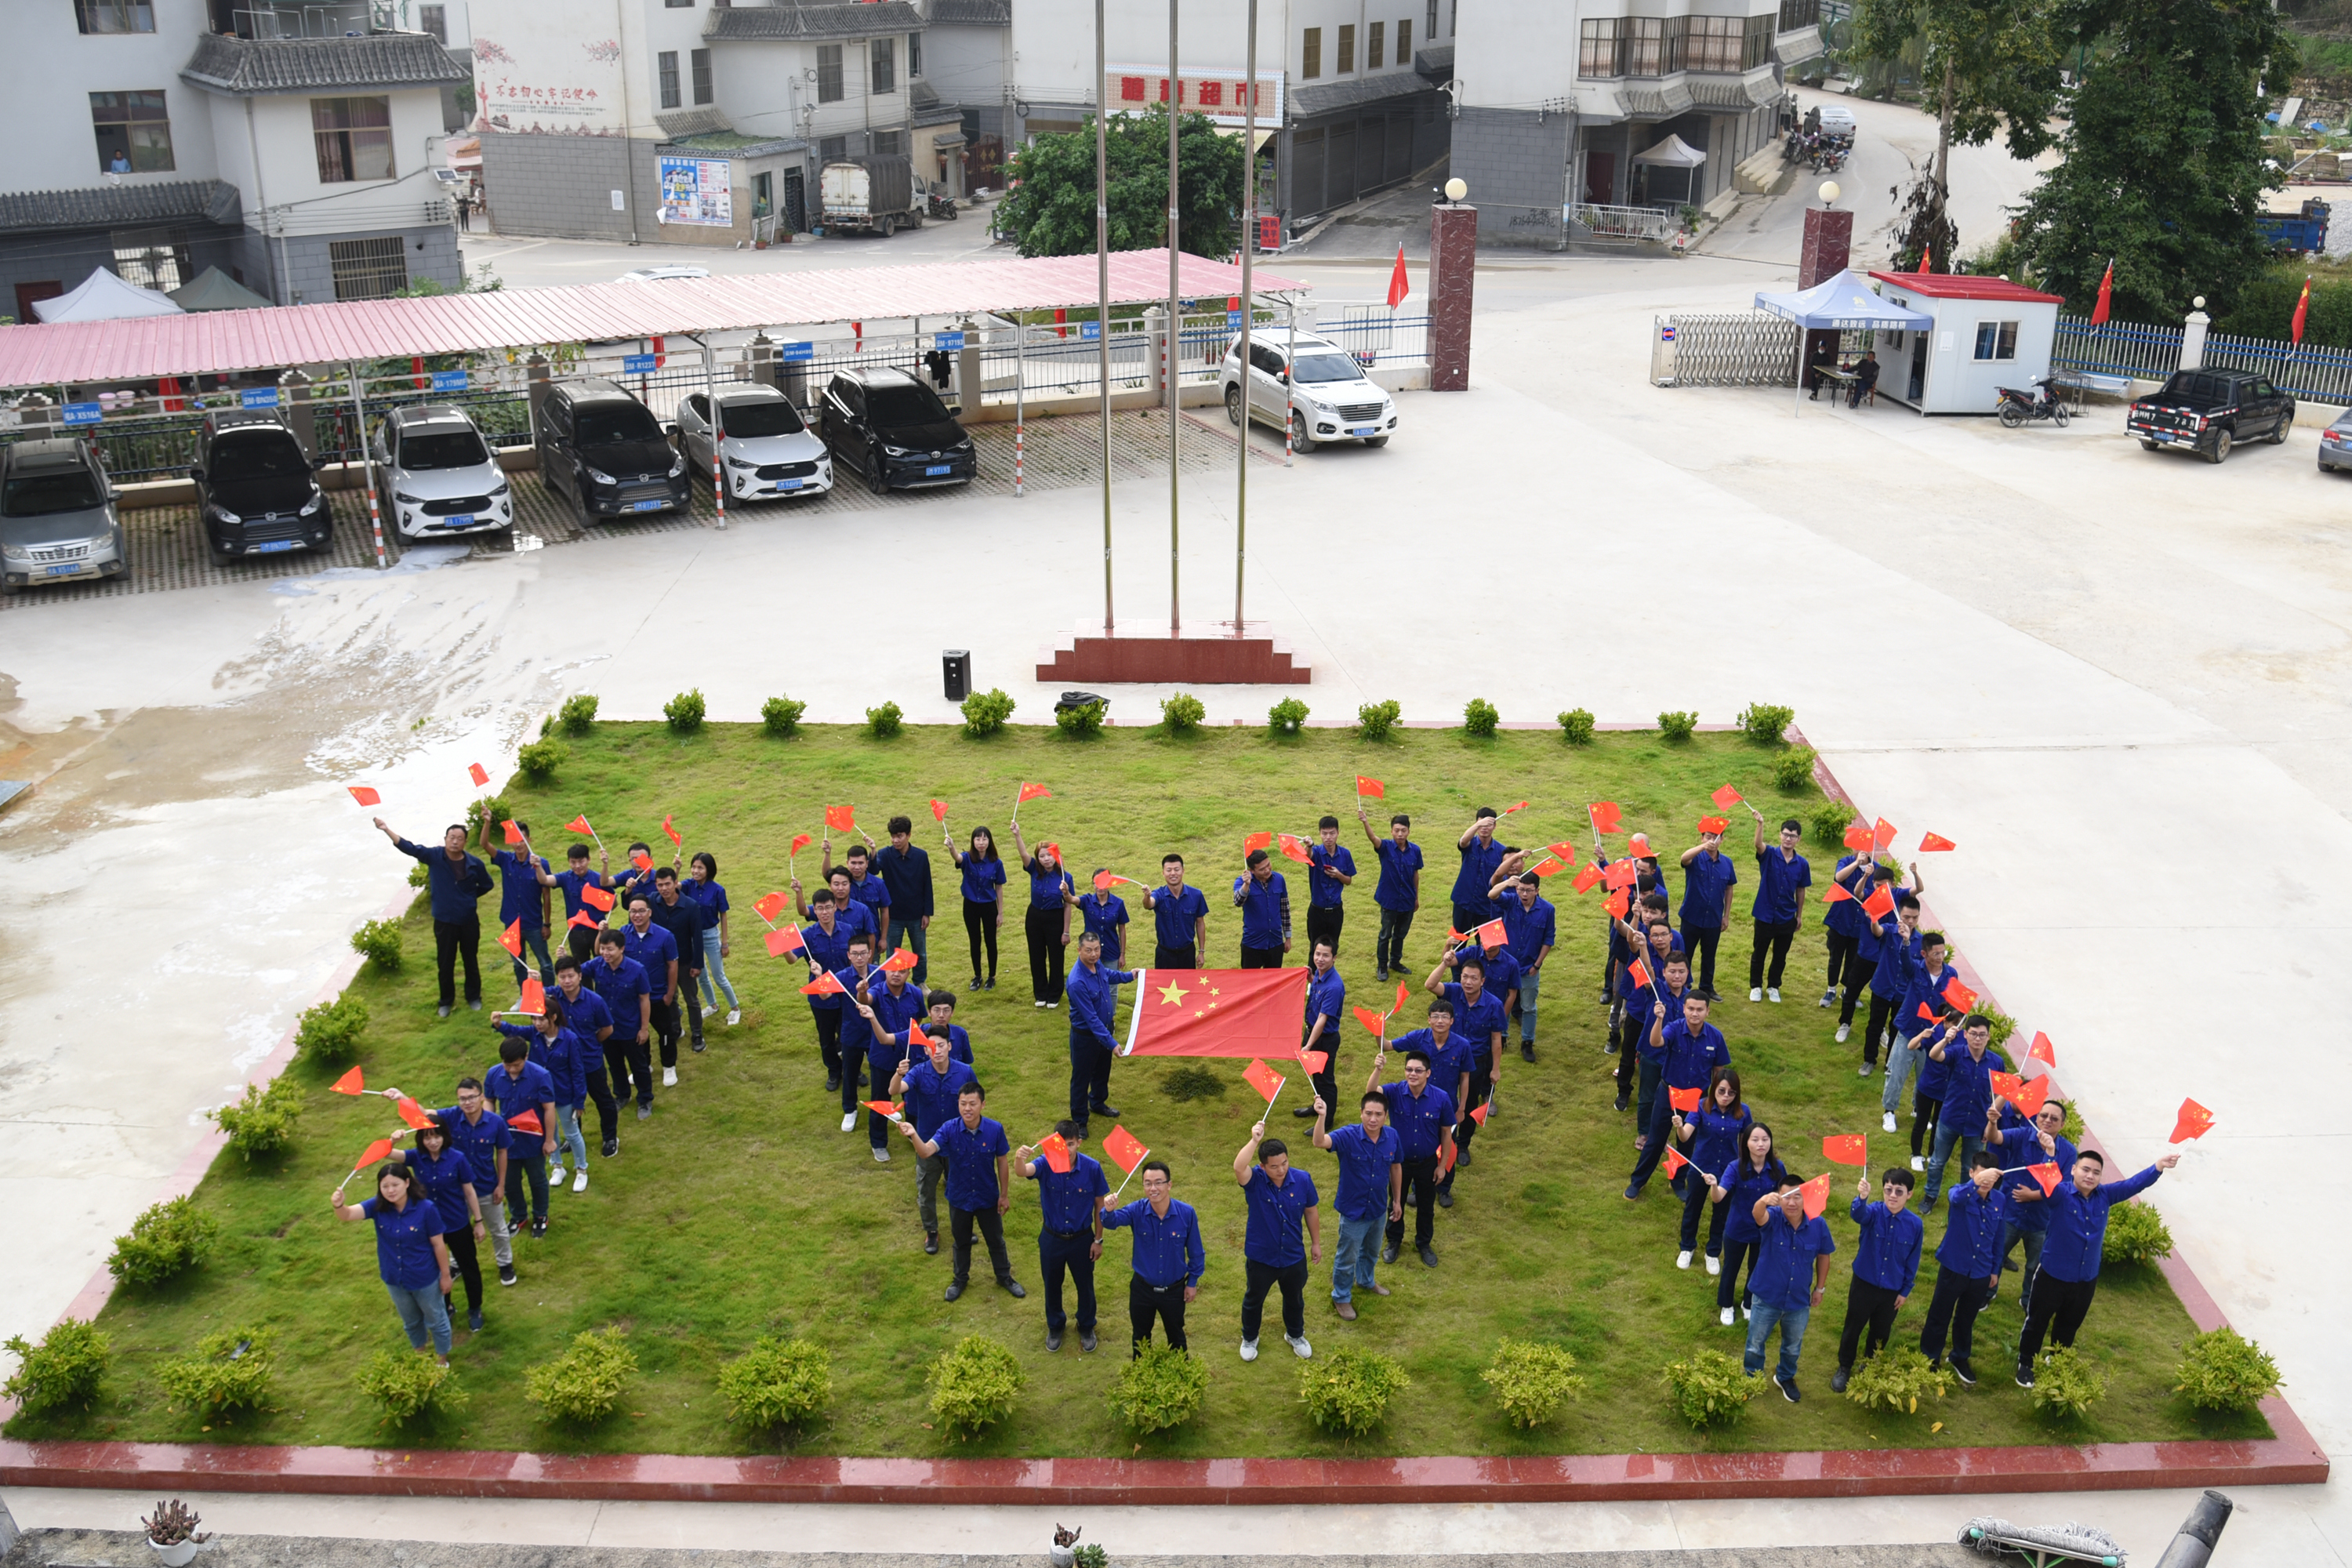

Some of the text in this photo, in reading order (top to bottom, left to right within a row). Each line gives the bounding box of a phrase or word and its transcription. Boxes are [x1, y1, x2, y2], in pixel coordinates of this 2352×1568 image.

[1831, 319, 1907, 329] 通达致远 品质路桥
